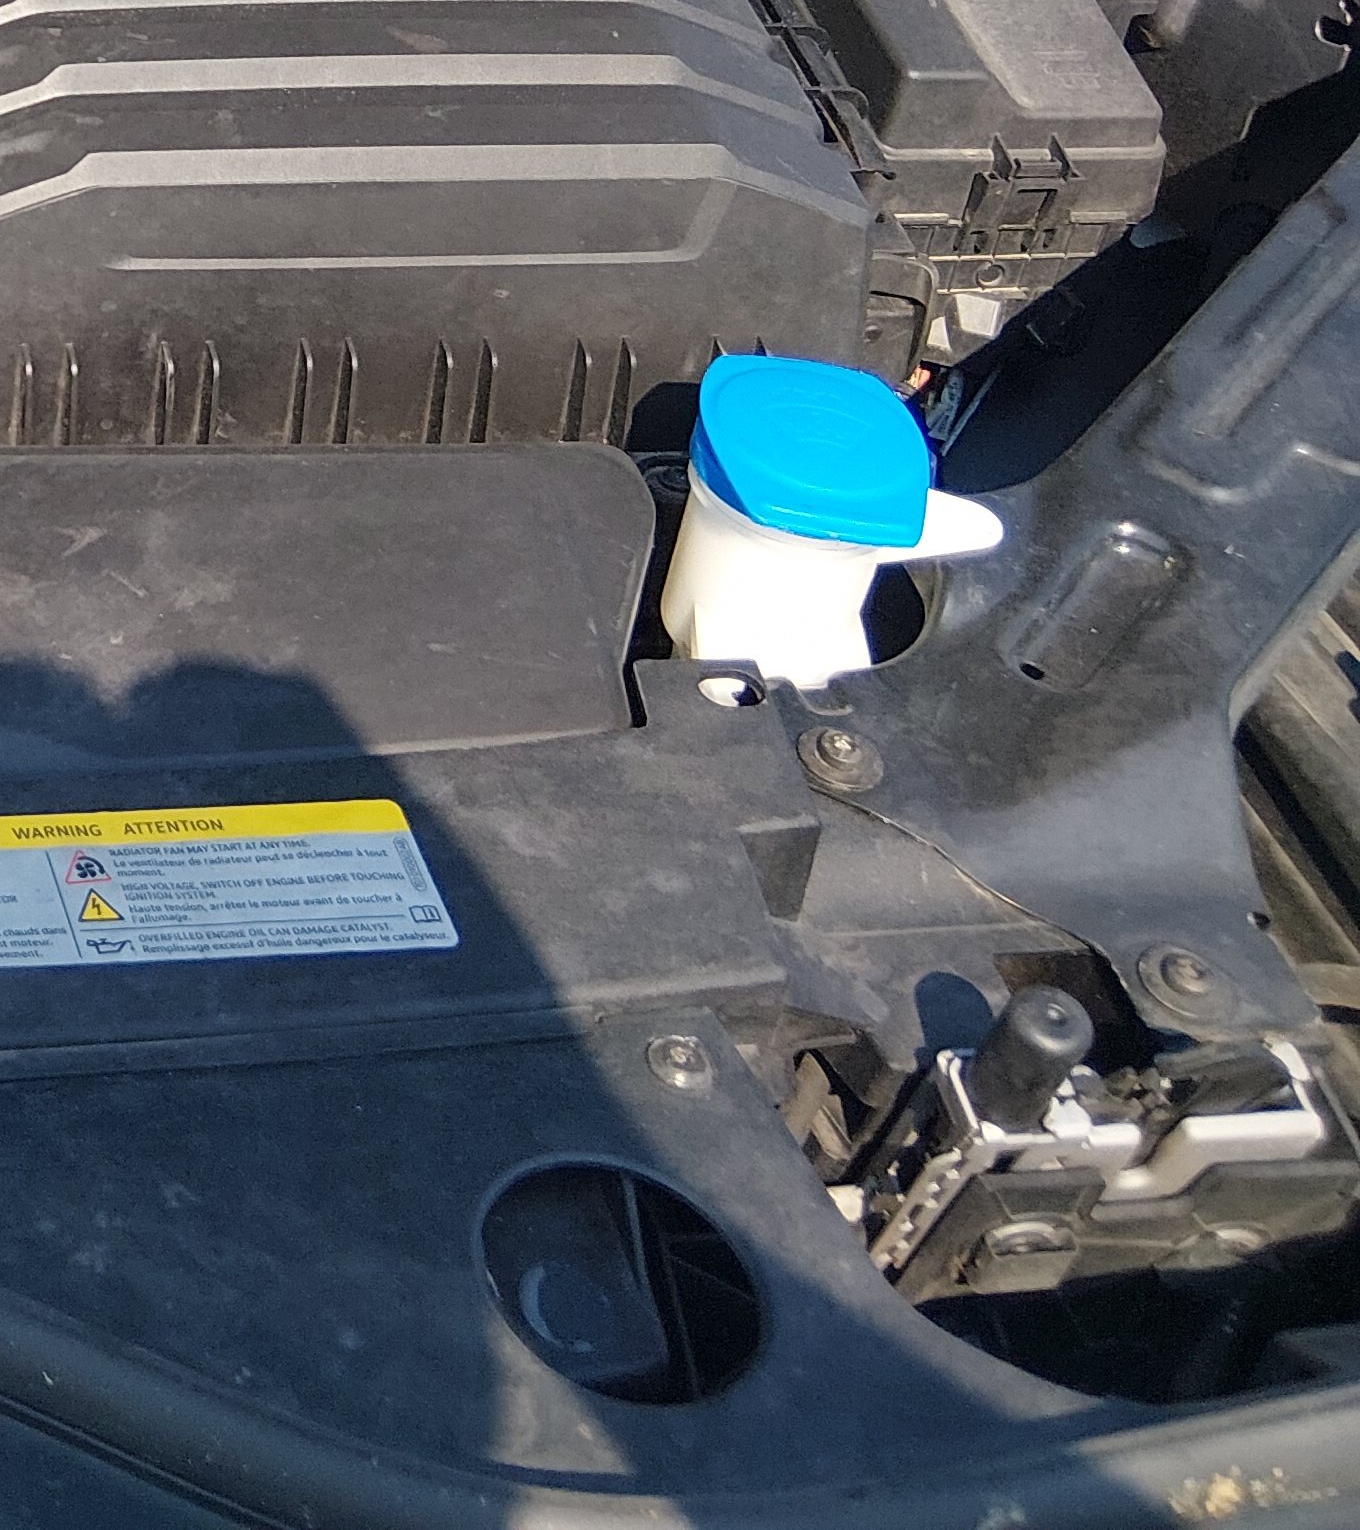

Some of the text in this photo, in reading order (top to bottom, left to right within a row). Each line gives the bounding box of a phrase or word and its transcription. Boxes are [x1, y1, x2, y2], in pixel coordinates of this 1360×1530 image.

[11, 819, 224, 840] WARNING ATTENTION
[109, 846, 161, 857] RADIATOR
[164, 845, 185, 855] FAN
[186, 844, 209, 854] MAY
[211, 842, 242, 853] START
[245, 841, 257, 850] AT
[259, 840, 284, 850] ANY
[113, 848, 389, 868] Le ventilateur de radiateur peut se déclencher à tout
[117, 869, 166, 877] moment.
[120, 871, 405, 892] HIGH VOLTAGE, SWITCH OFF ENGINE BEFORE TOUCHING
[124, 891, 173, 901] IGNITION
[128, 894, 402, 914] Haute tension, arrêter le moteur avant de toucher à
[2, 927, 40, 936] chauds
[42, 926, 67, 935] dans
[138, 922, 392, 943] OVERFILLED ENGINE OIL CAN DAMAGE CATALYST.
[142, 931, 450, 954] Remplissage excessif d'huile dangereux pour le catalyseur.
